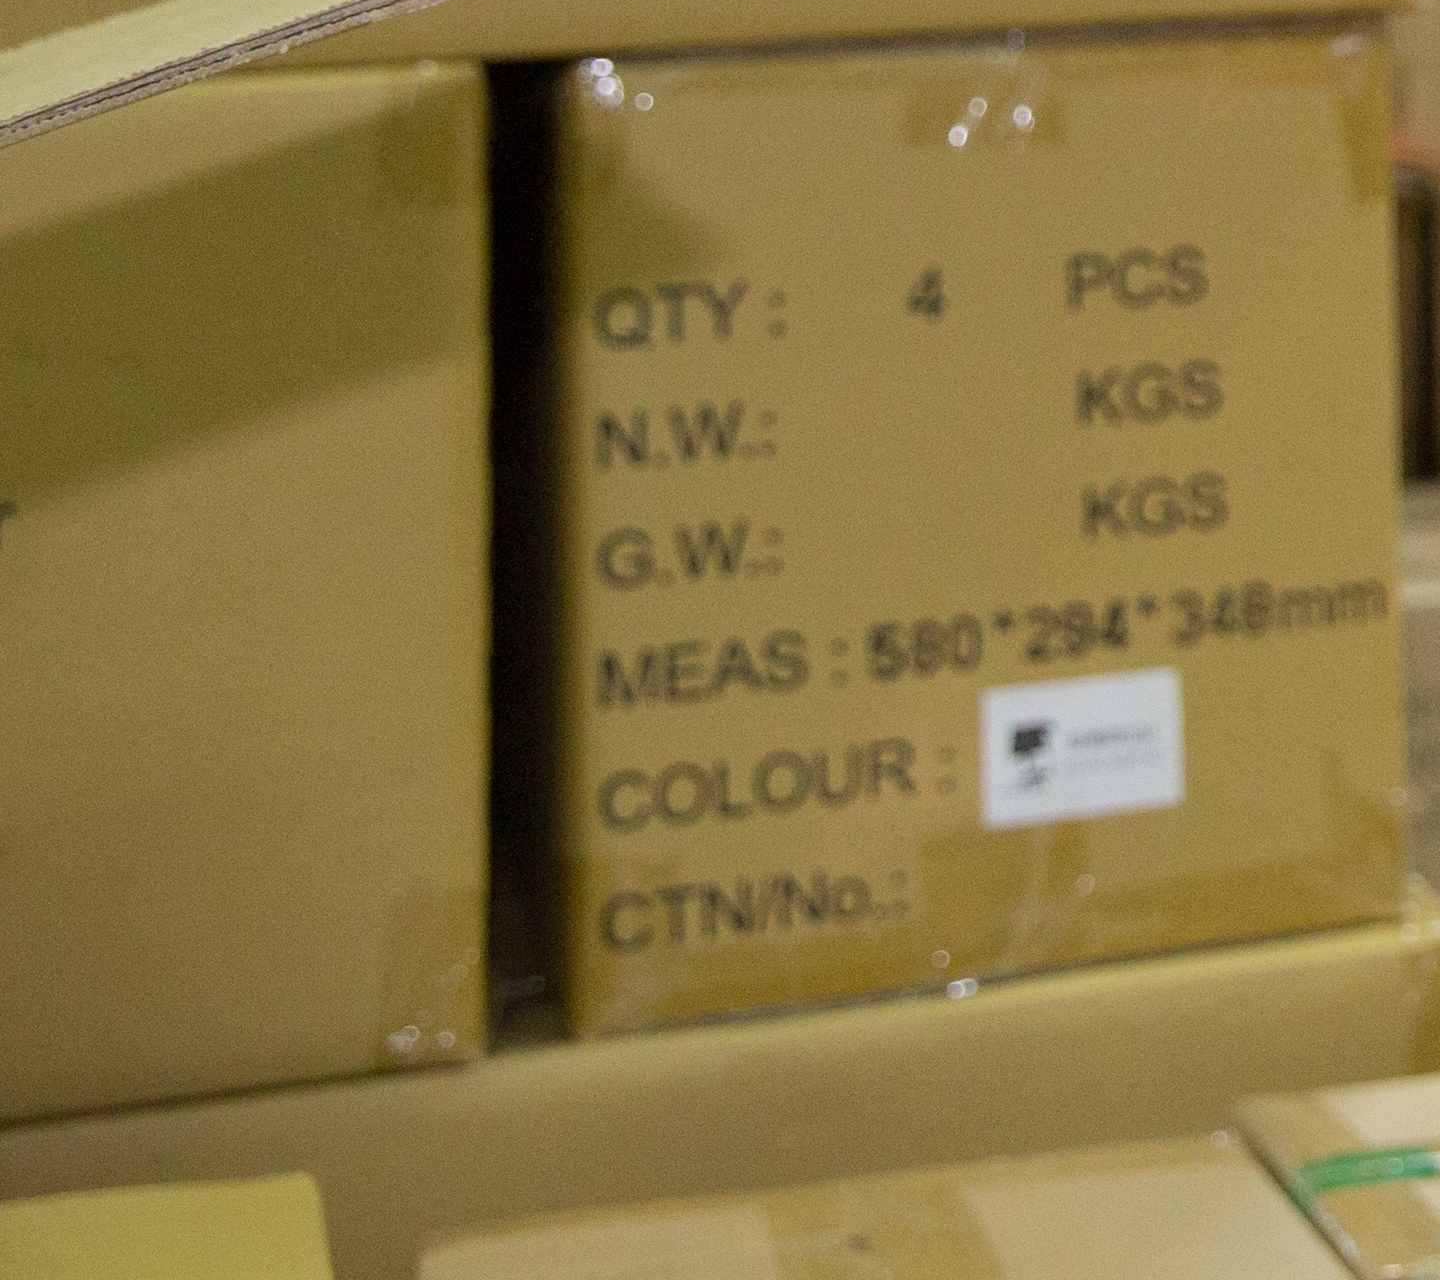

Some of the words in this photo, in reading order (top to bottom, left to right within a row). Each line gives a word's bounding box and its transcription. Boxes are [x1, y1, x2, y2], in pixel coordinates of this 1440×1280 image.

[906, 269, 946, 319] 4
[1064, 244, 1209, 311] PCS
[1075, 359, 1223, 426] KGS
[1081, 472, 1229, 539] KGS
